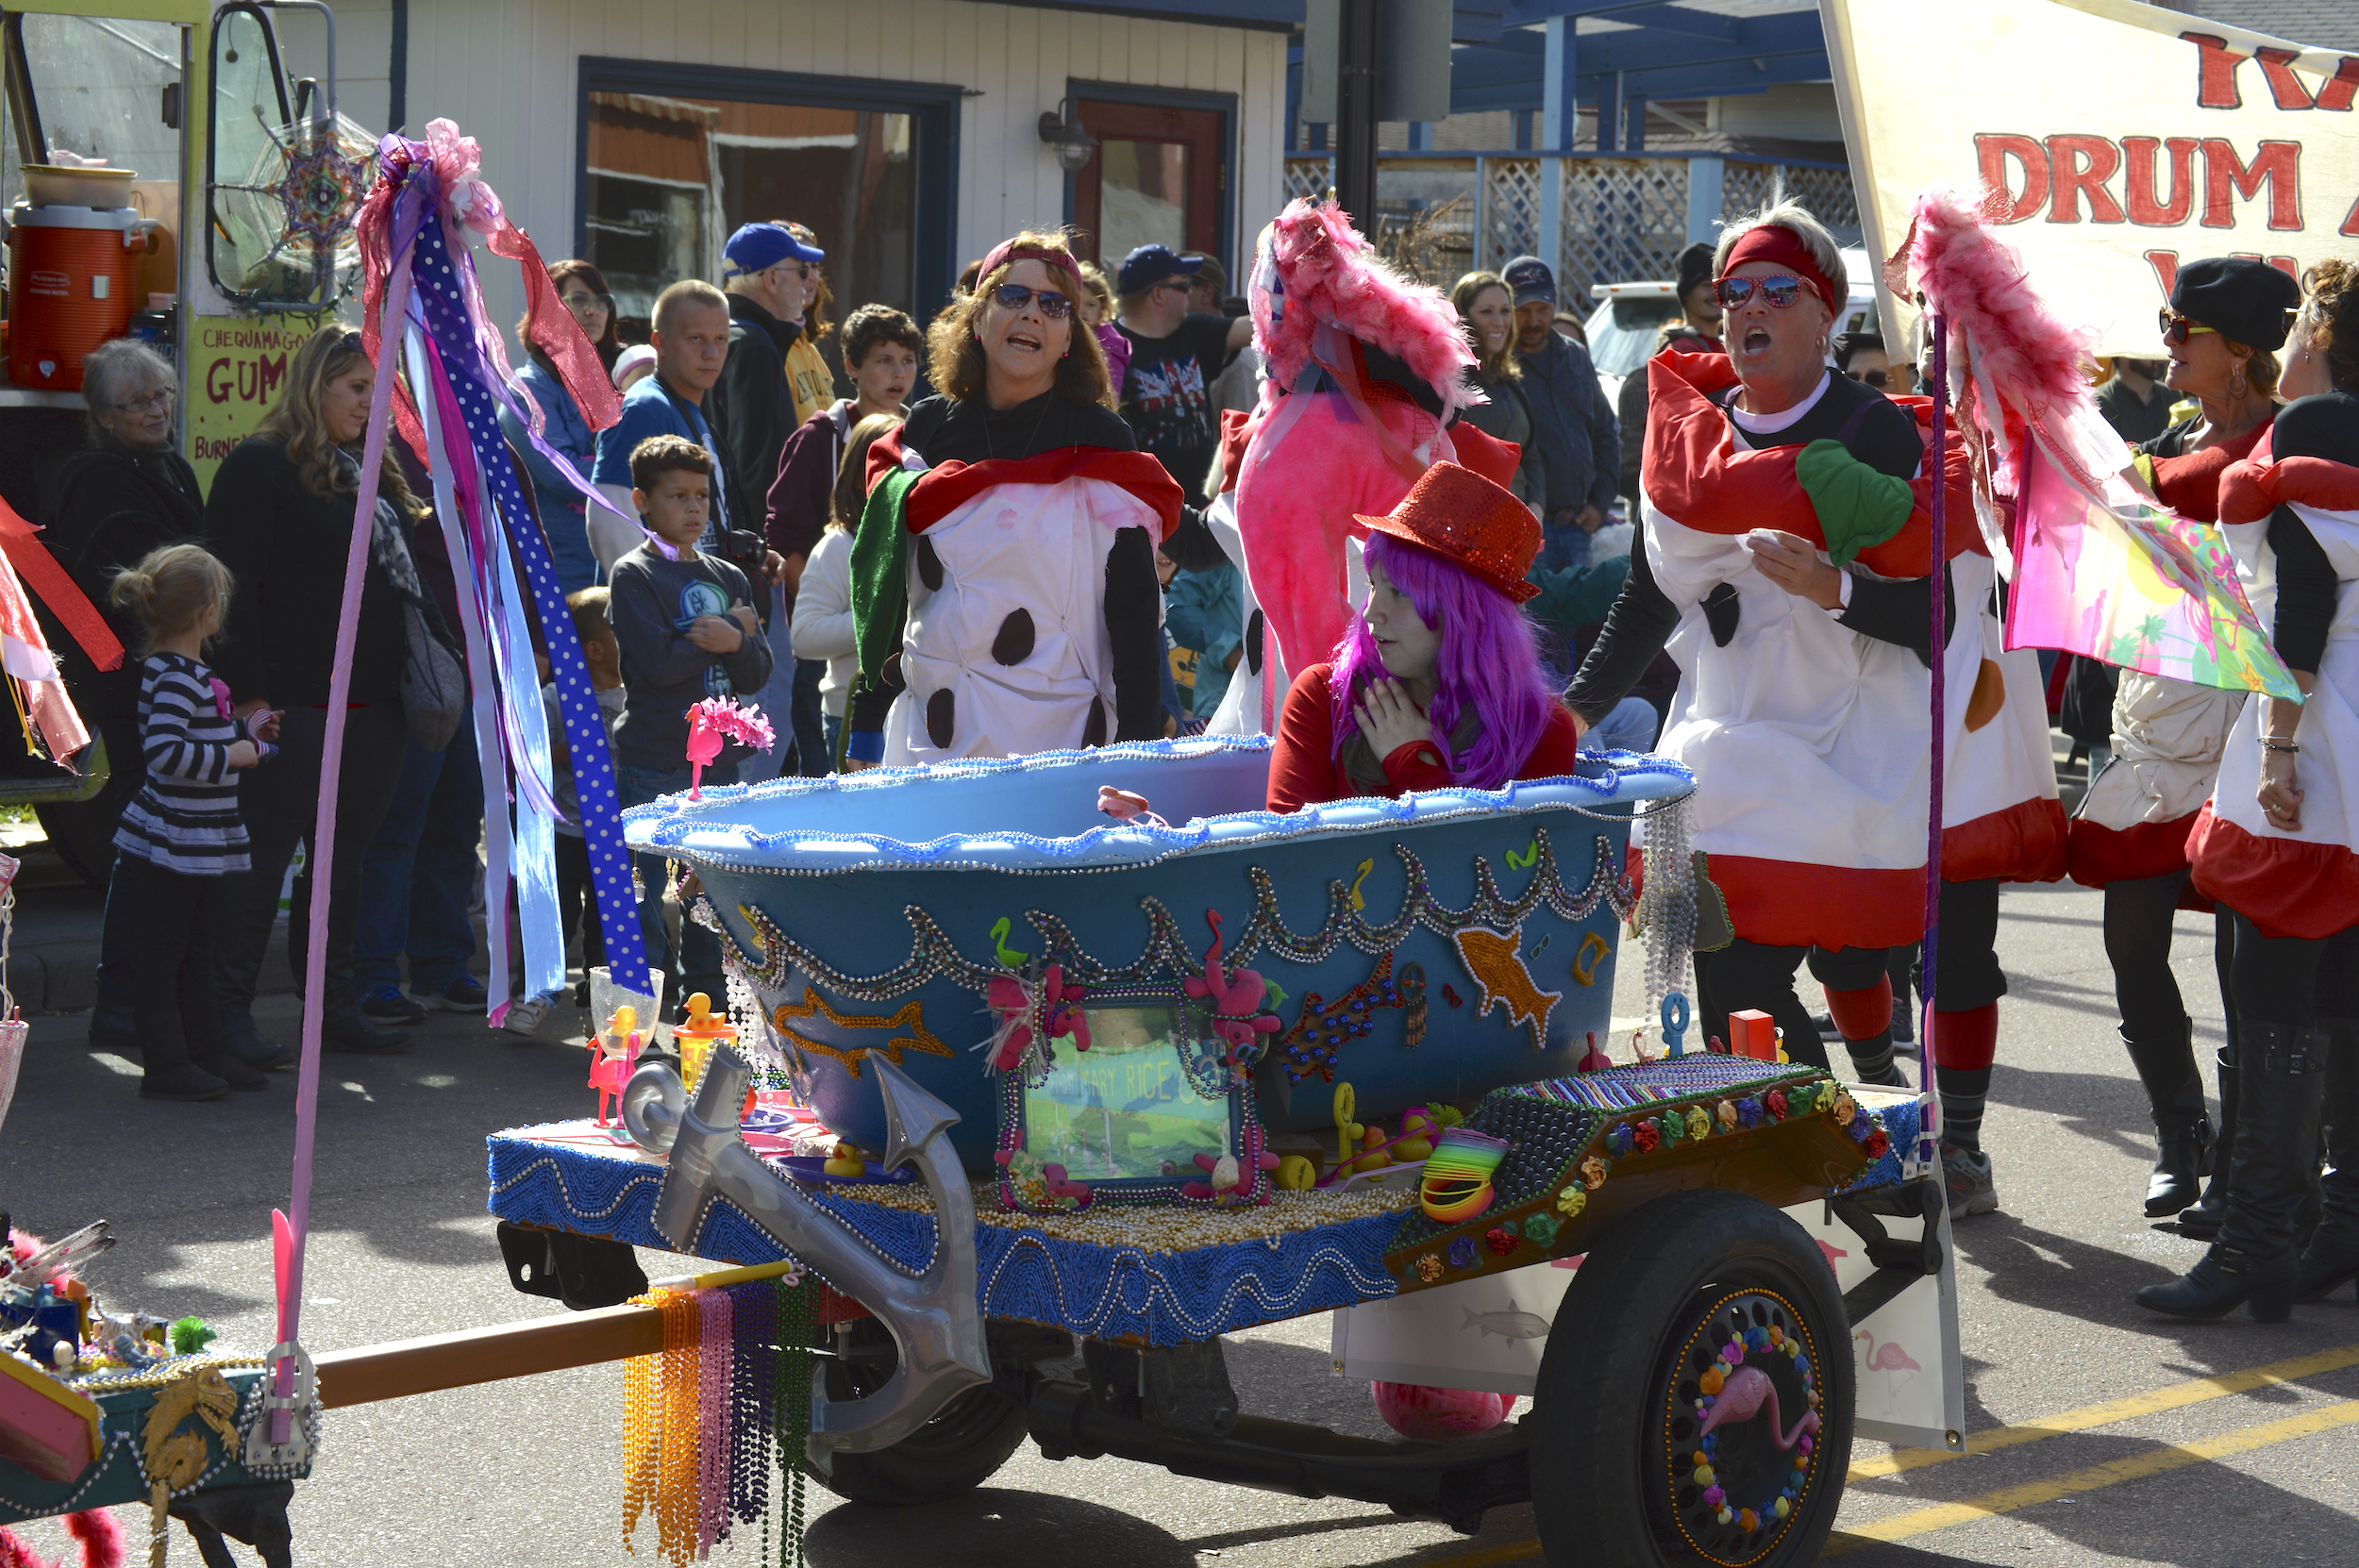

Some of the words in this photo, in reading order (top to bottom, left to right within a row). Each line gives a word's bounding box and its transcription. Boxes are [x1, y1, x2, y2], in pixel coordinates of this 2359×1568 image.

[1973, 133, 2305, 231] DRUM
[203, 328, 315, 351] CHEQUAMAGO
[1127, 1060, 1172, 1101] RICE
